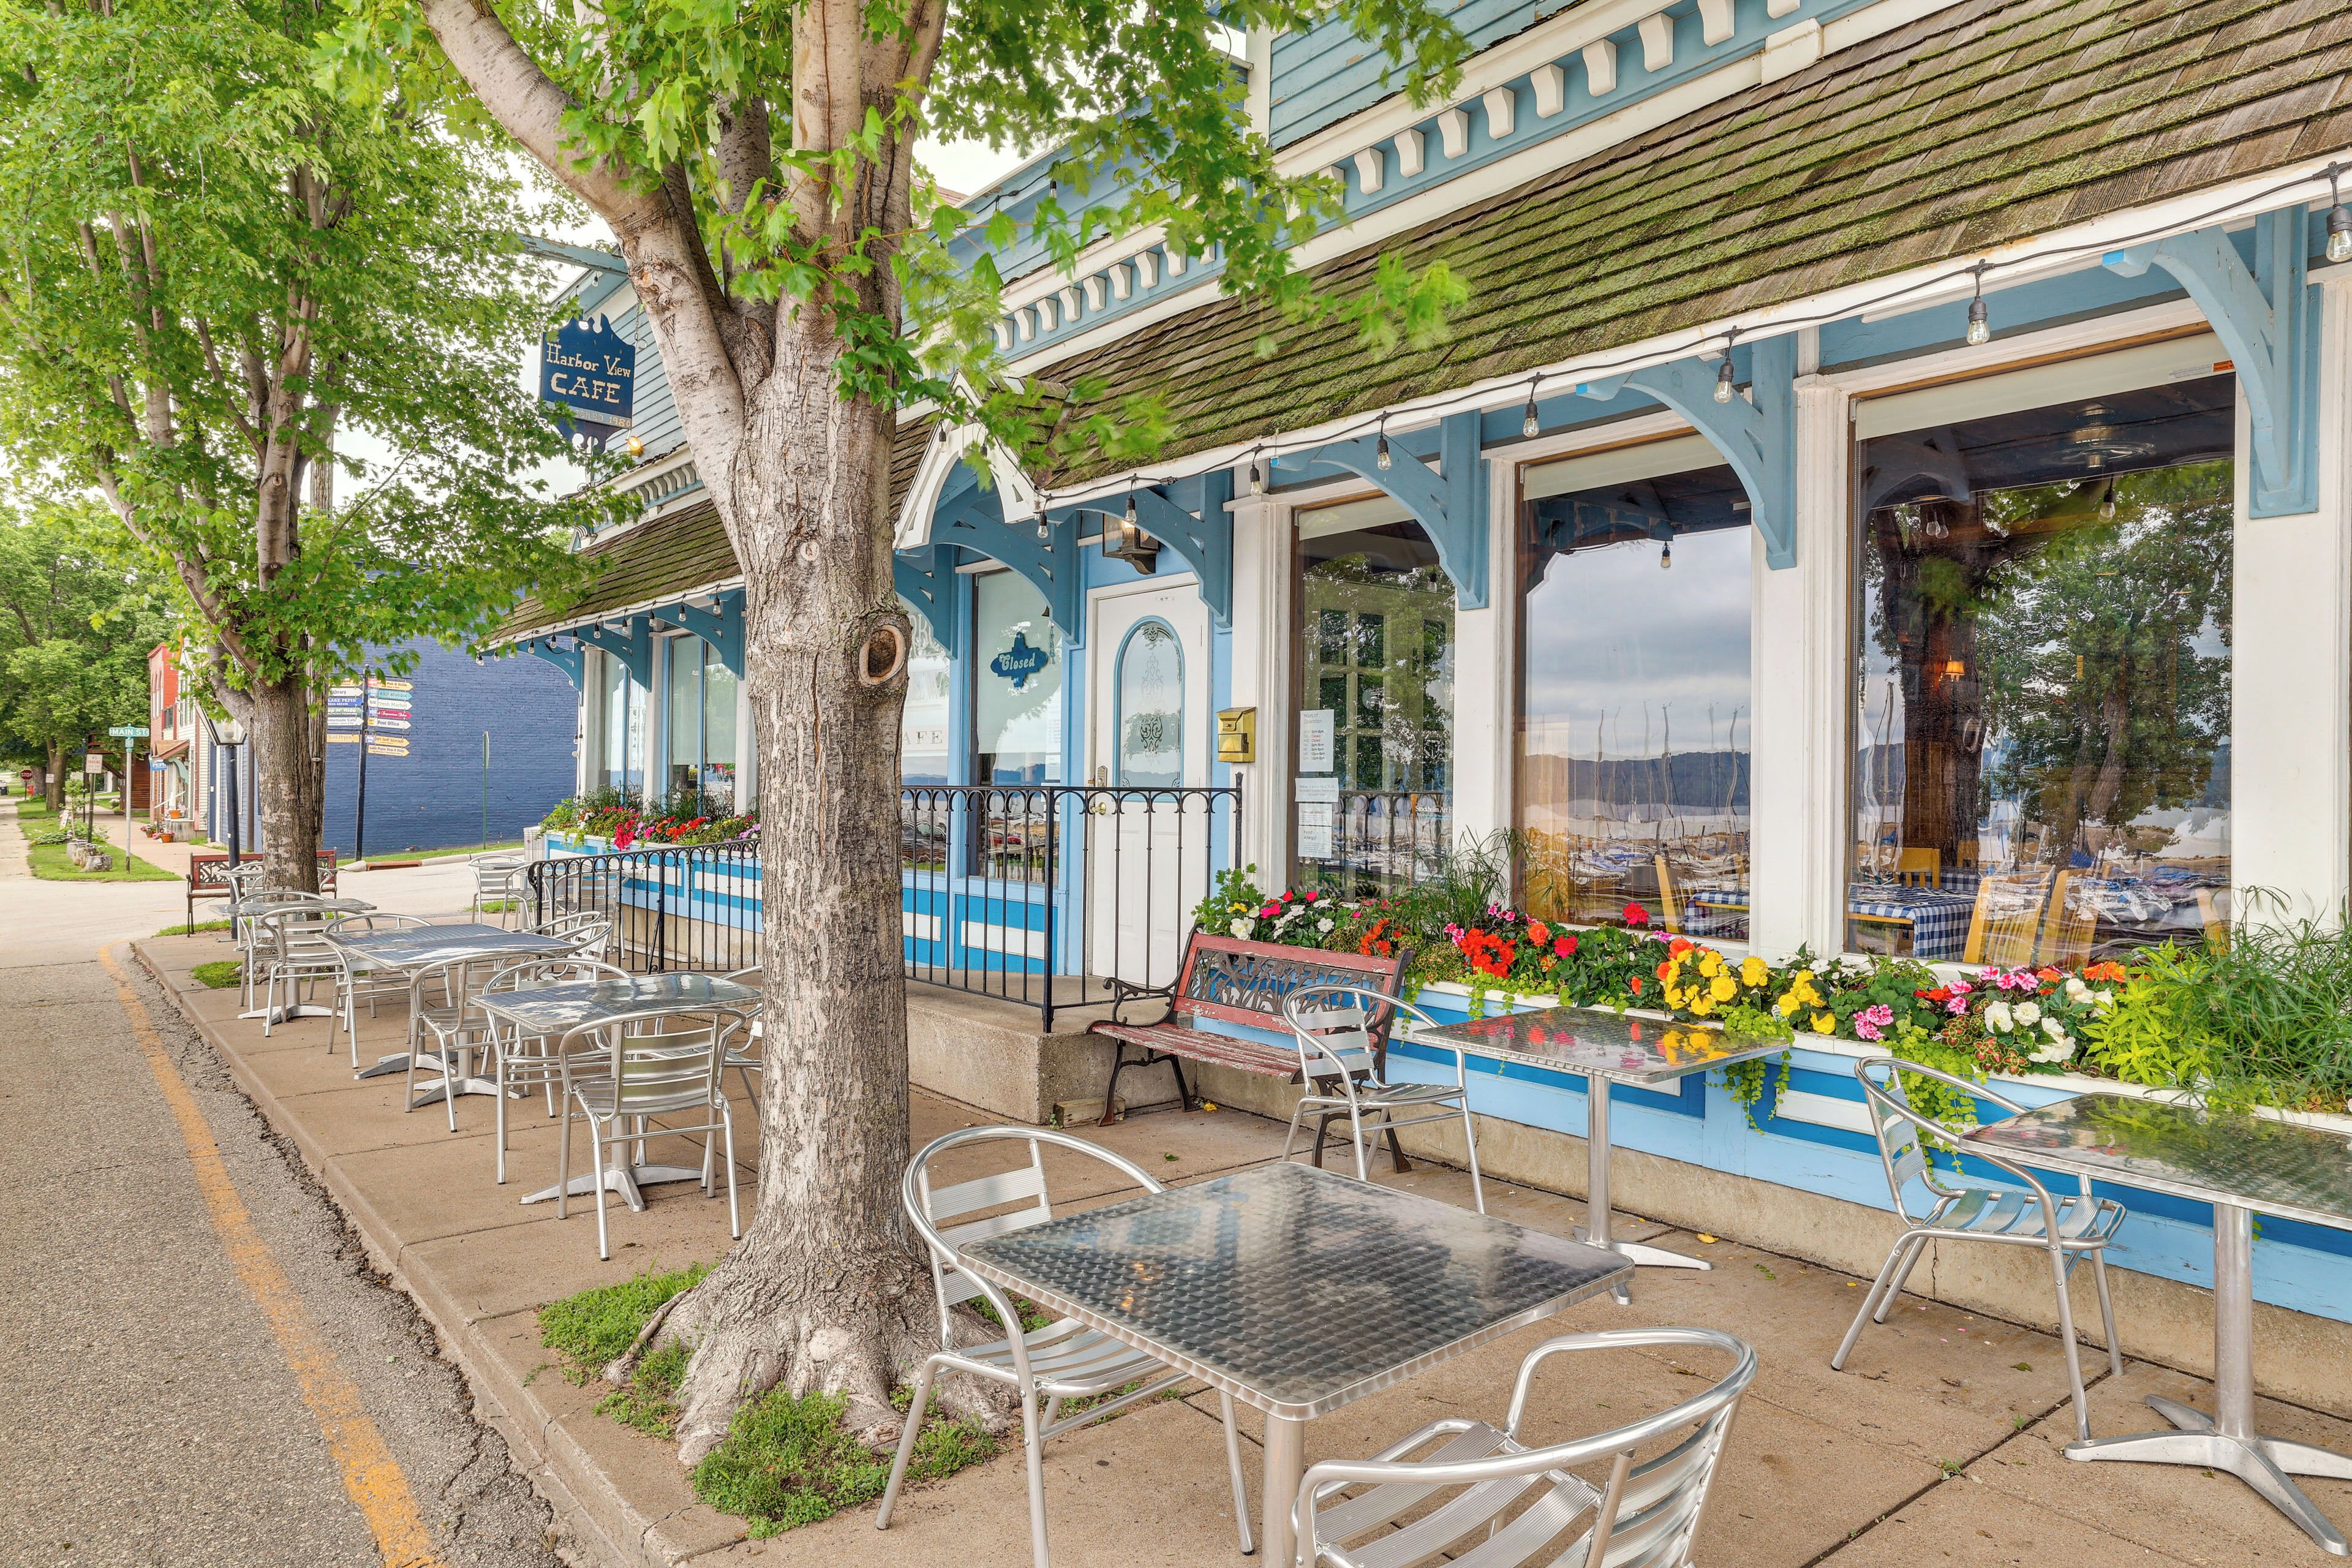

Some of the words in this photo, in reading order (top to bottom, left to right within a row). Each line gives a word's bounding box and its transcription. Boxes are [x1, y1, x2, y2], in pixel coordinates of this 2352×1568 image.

[546, 342, 600, 371] Harbor
[603, 355, 631, 378] View
[551, 372, 621, 404] CAFE
[609, 416, 631, 428] 1980
[999, 652, 1035, 671] Closed
[903, 730, 942, 745] AFE
